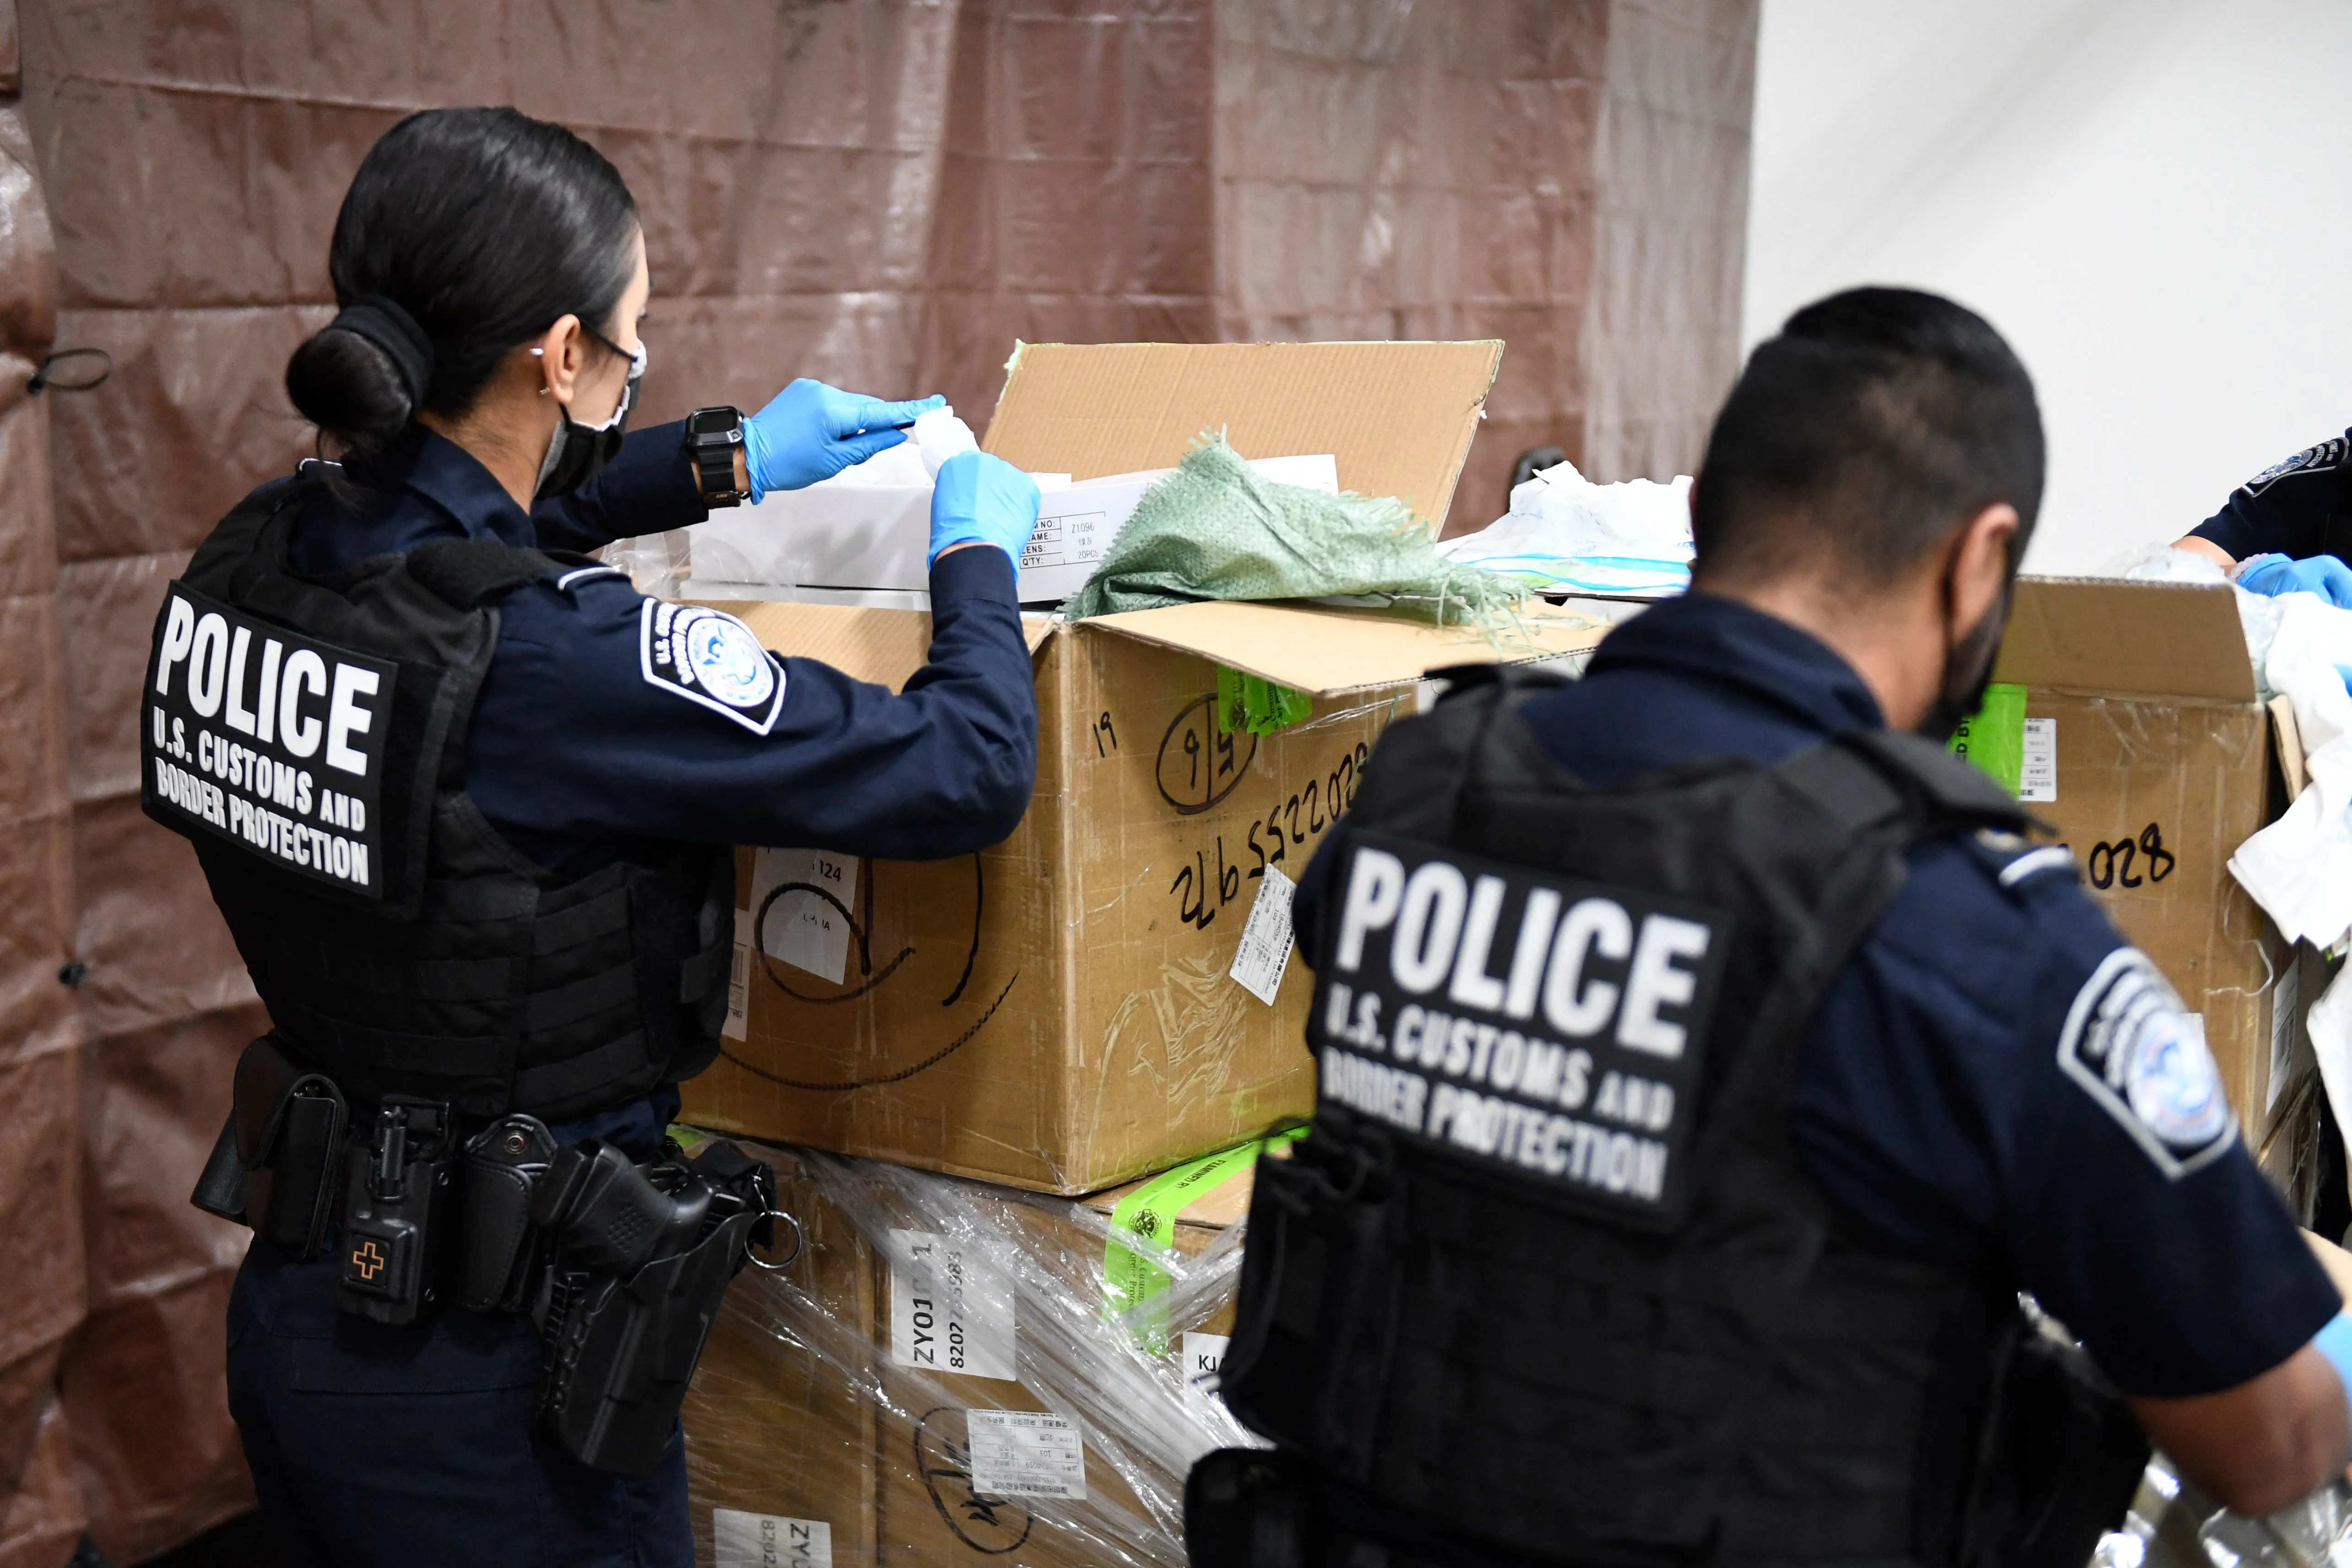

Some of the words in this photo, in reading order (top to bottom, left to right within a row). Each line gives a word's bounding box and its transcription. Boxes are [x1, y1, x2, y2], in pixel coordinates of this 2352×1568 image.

[1022, 557, 1043, 566] Q'TY:
[1078, 549, 1099, 559] 20PCS
[1029, 532, 1052, 542] AME:
[1040, 520, 1055, 528] NO:
[156, 595, 379, 776] POLICE
[153, 705, 192, 763] U.S.
[198, 730, 313, 815] CUSTOMS
[320, 788, 366, 832] AND
[155, 756, 226, 829] BORDER
[229, 794, 369, 885] PROTECTION
[2089, 822, 2174, 889] 028
[1336, 846, 1710, 1059] POLICE
[1325, 982, 1387, 1052] U.S.
[1392, 1004, 1593, 1110] CUSTOMS
[1593, 1070, 1676, 1131] AND
[1321, 1045, 1428, 1134] BORDER
[1428, 1081, 1669, 1202] PROTECTION
[1187, 1159, 1227, 1182] EXAMINED
[1139, 1268, 1147, 1303] Custom
[1198, 1354, 1221, 1373] KJ
